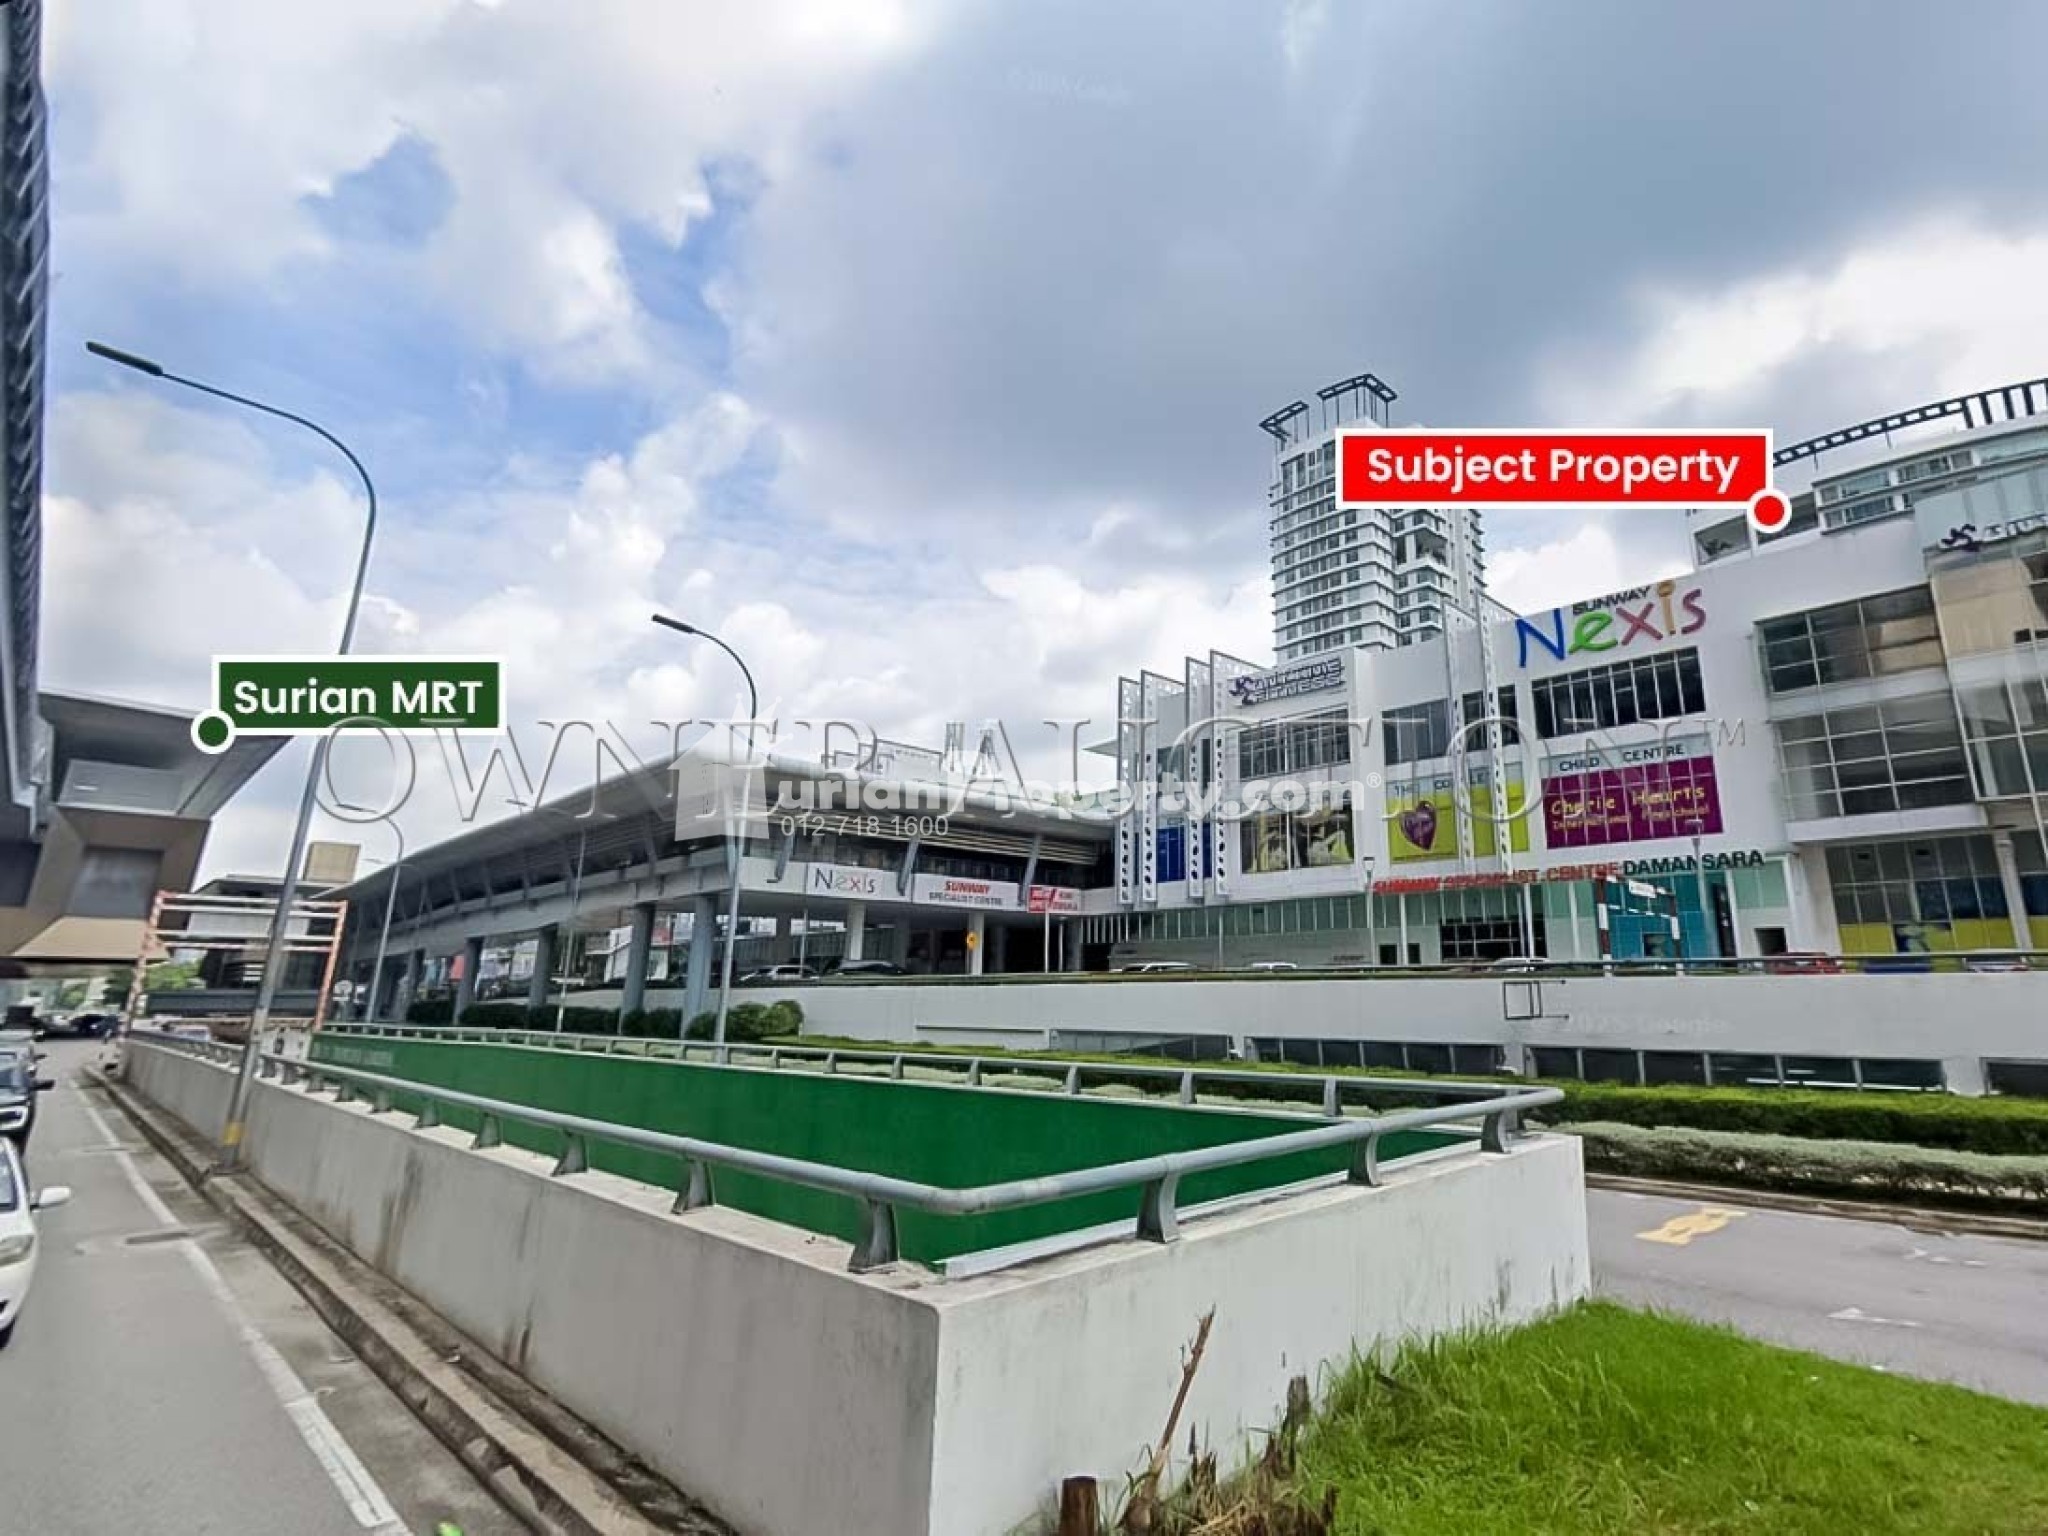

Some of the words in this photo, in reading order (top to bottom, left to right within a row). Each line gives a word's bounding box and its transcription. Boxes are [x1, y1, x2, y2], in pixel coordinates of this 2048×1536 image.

[1572, 585, 1650, 615] SUNWAY
[1515, 579, 1707, 669] Nexis
[1560, 757, 1600, 771] CHILD
[1623, 743, 1686, 762] CENTRE
[1623, 850, 1765, 876] DAMANSARA
[814, 867, 876, 893] Nexis
